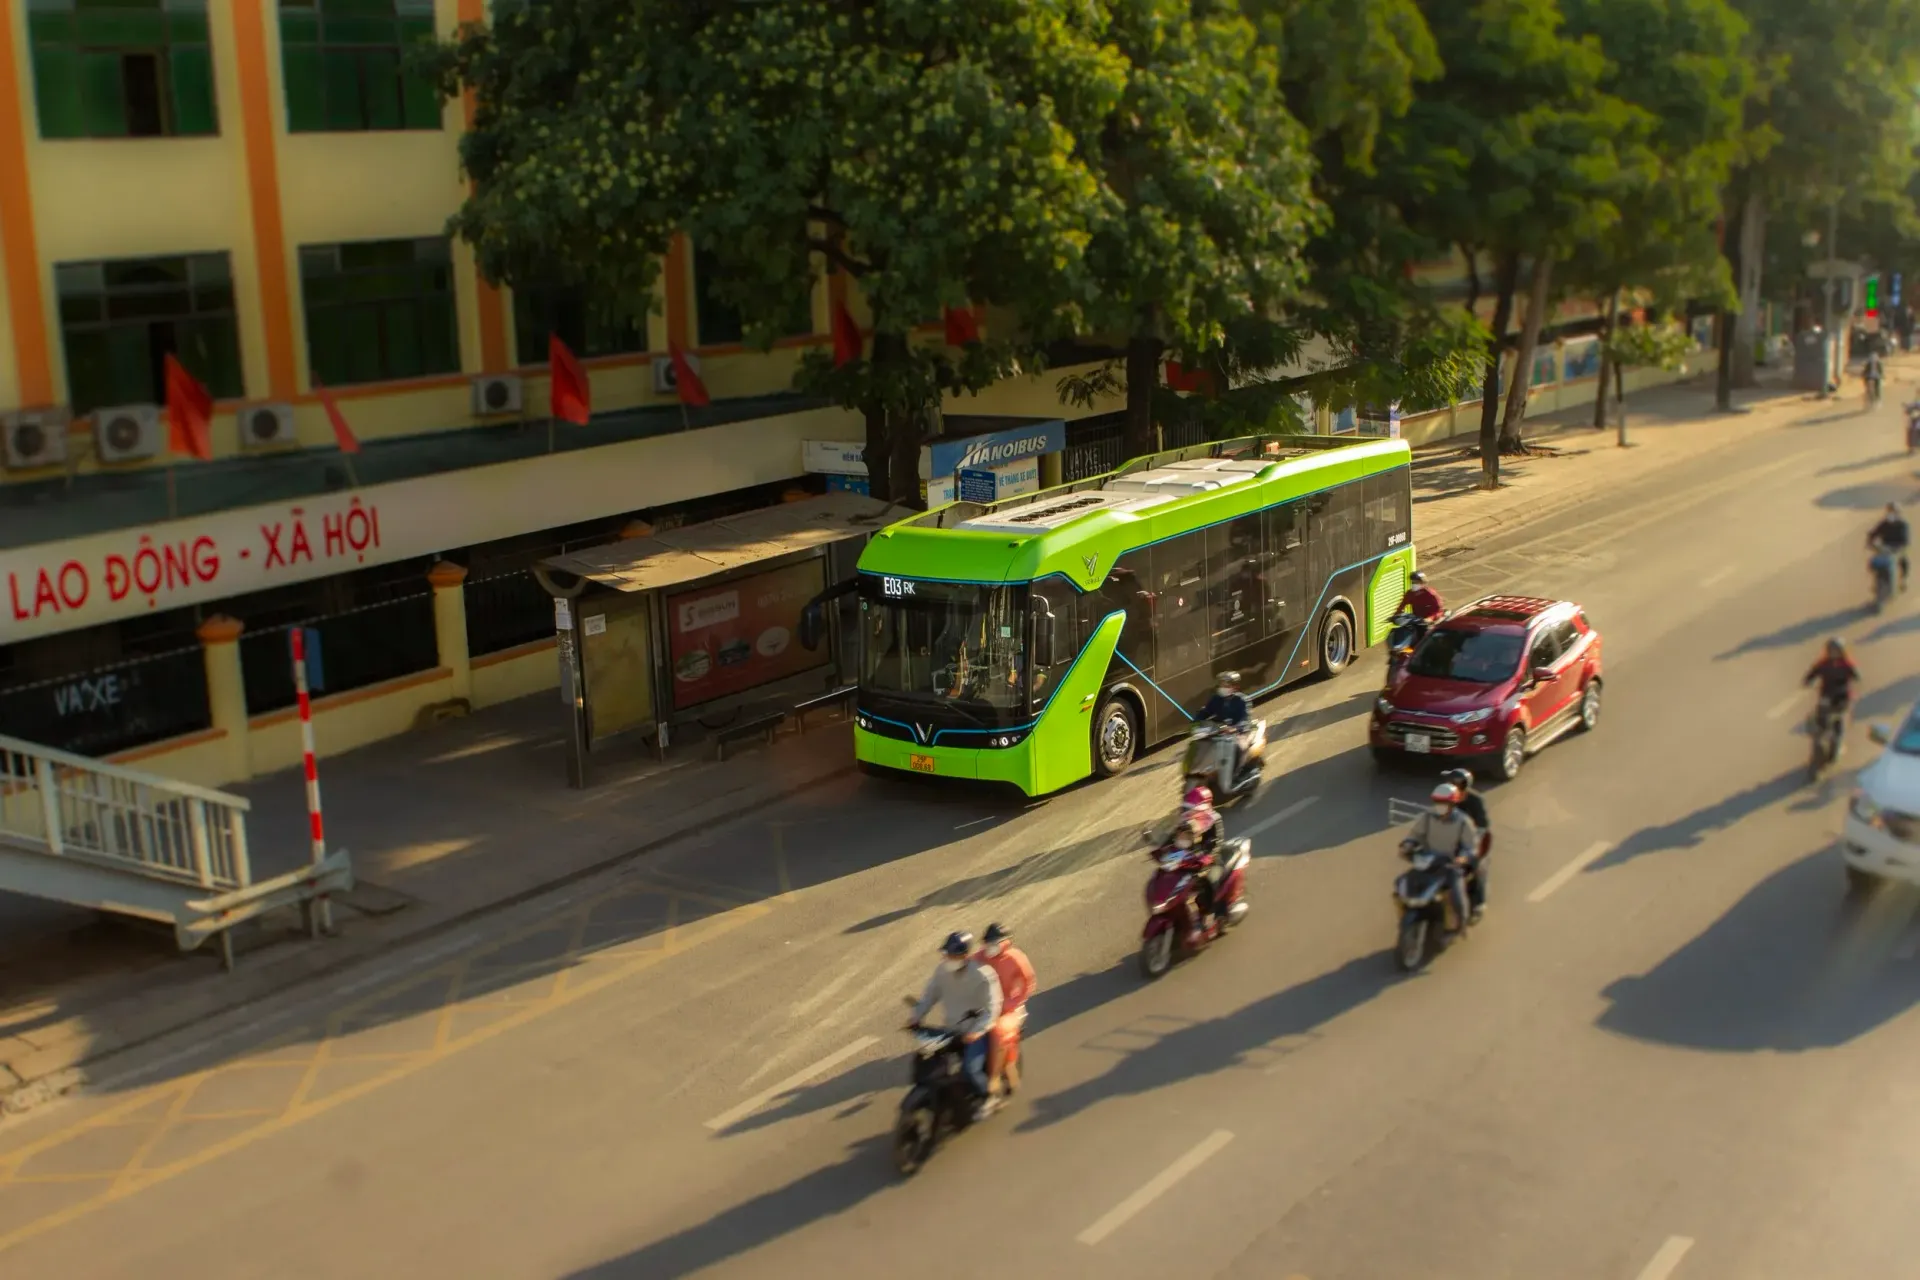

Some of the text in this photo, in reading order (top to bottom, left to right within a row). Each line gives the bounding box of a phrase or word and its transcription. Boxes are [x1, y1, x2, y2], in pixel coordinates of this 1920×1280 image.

[956, 435, 1047, 469] HANOIBUS
[8, 559, 91, 622] LAO
[104, 534, 220, 608] ĐỘNG
[259, 507, 314, 570] XÃ
[322, 496, 381, 564] HỘI
[883, 576, 902, 595] E03
